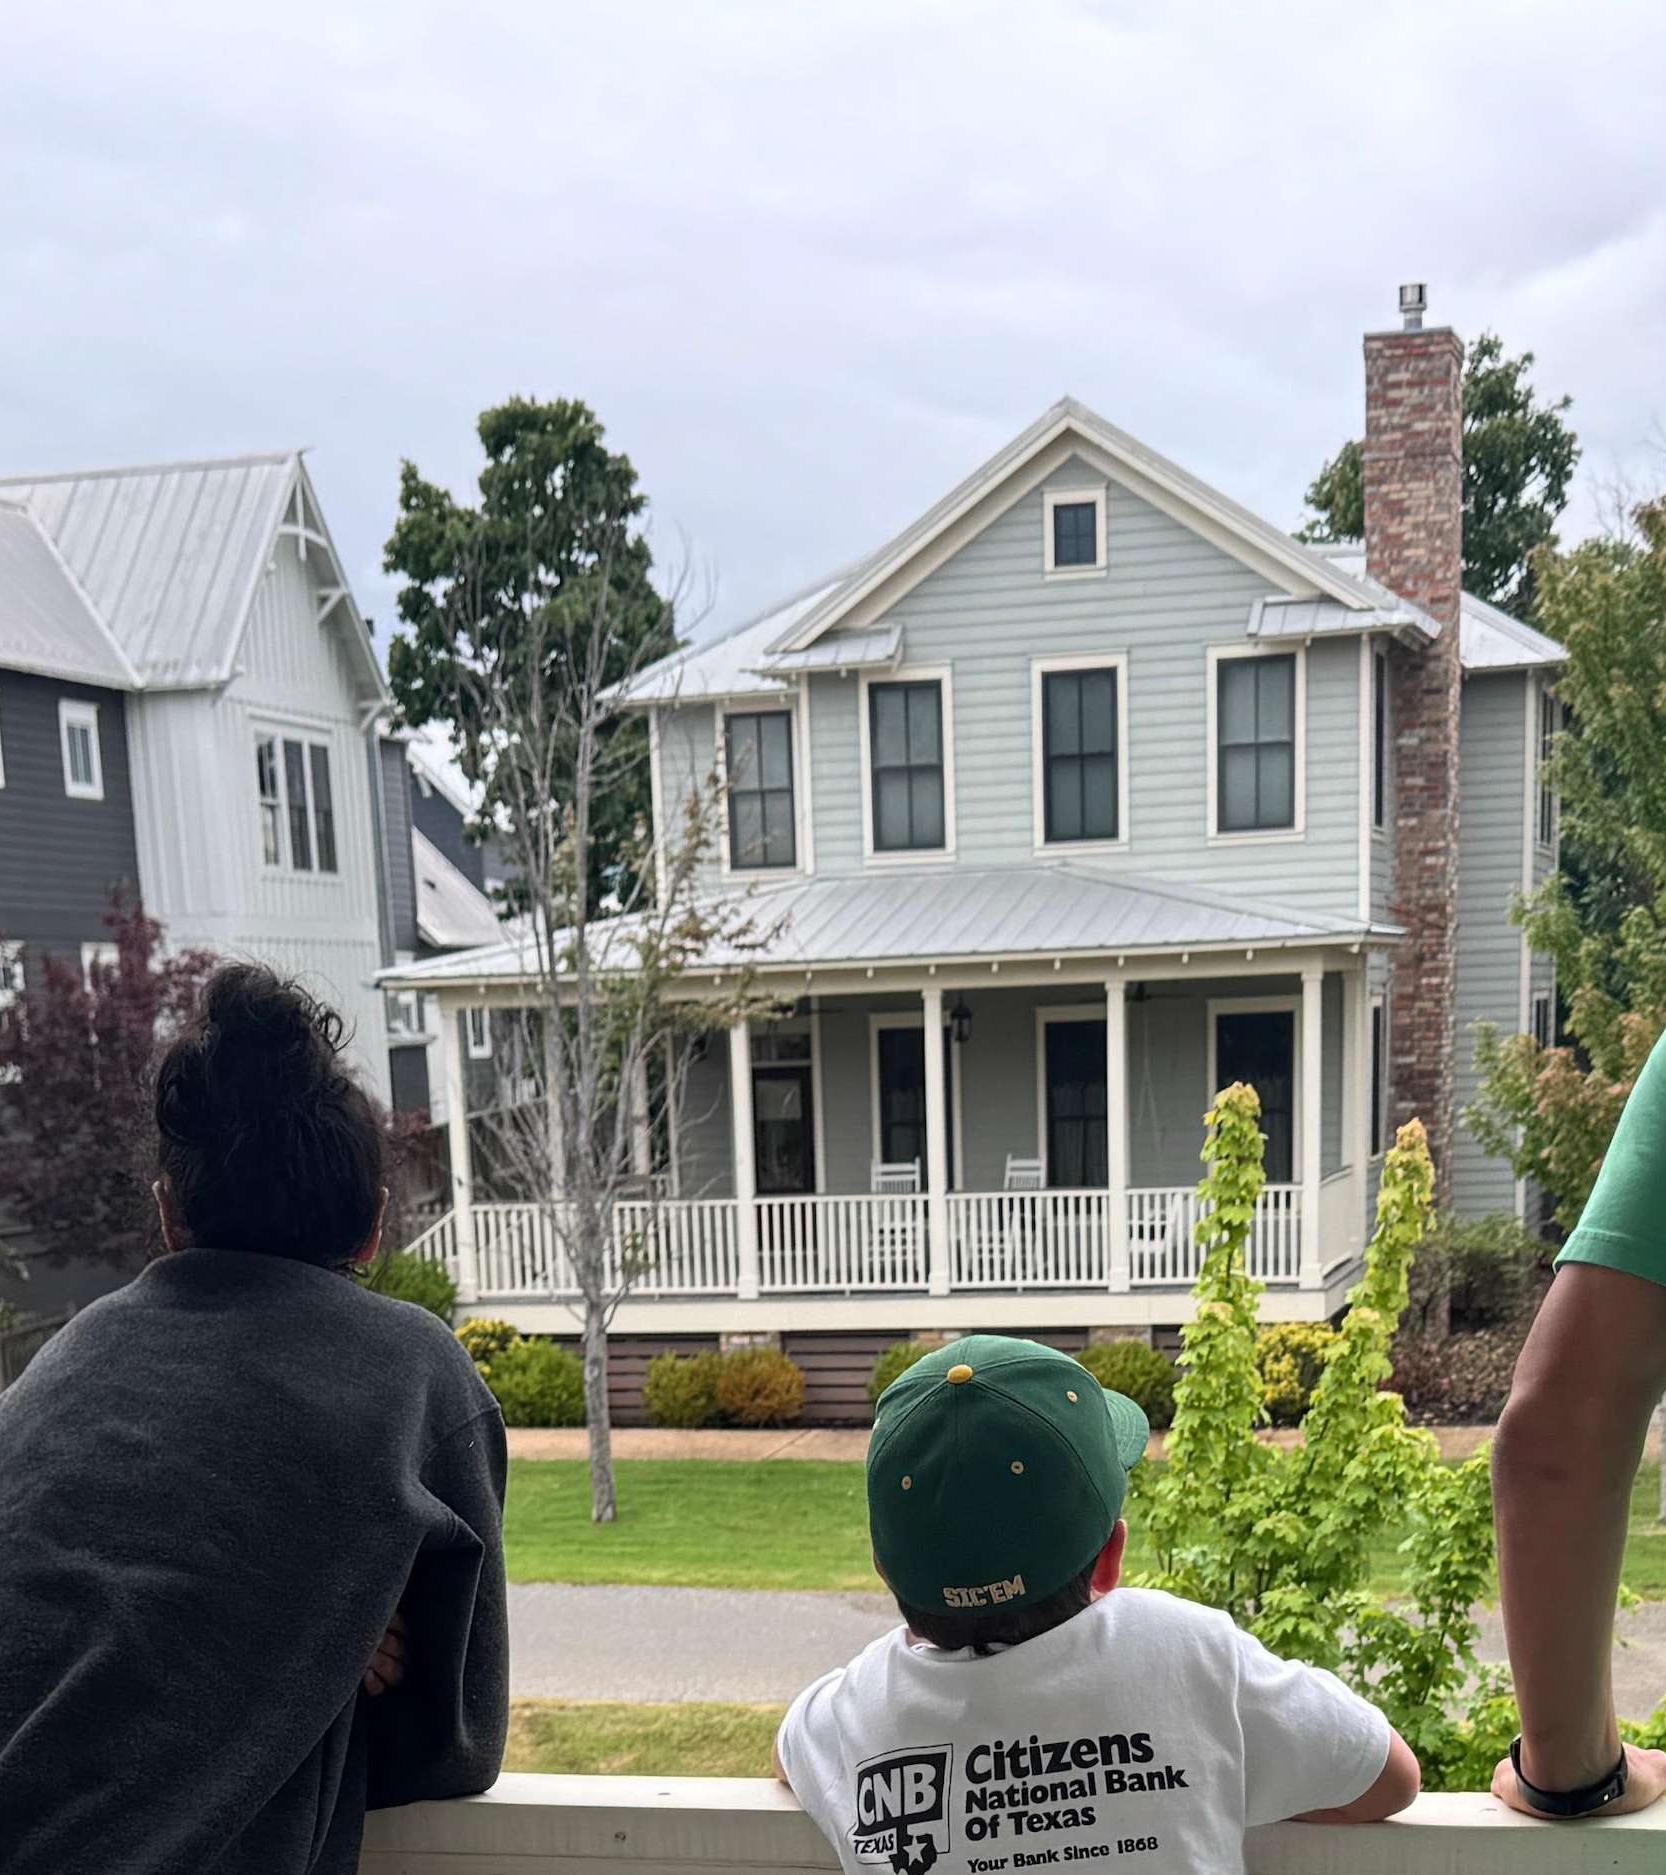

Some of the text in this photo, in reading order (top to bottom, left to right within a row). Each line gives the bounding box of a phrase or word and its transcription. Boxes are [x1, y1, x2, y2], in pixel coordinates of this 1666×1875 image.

[965, 1732, 1154, 1785] Citizens
[858, 1763, 937, 1826] CNB
[965, 1765, 1190, 1814] National Bank
[853, 1833, 895, 1855] TEXAS
[965, 1806, 1096, 1842] Of Texas
[967, 1836, 1159, 1874] Your Bank Since 1868
